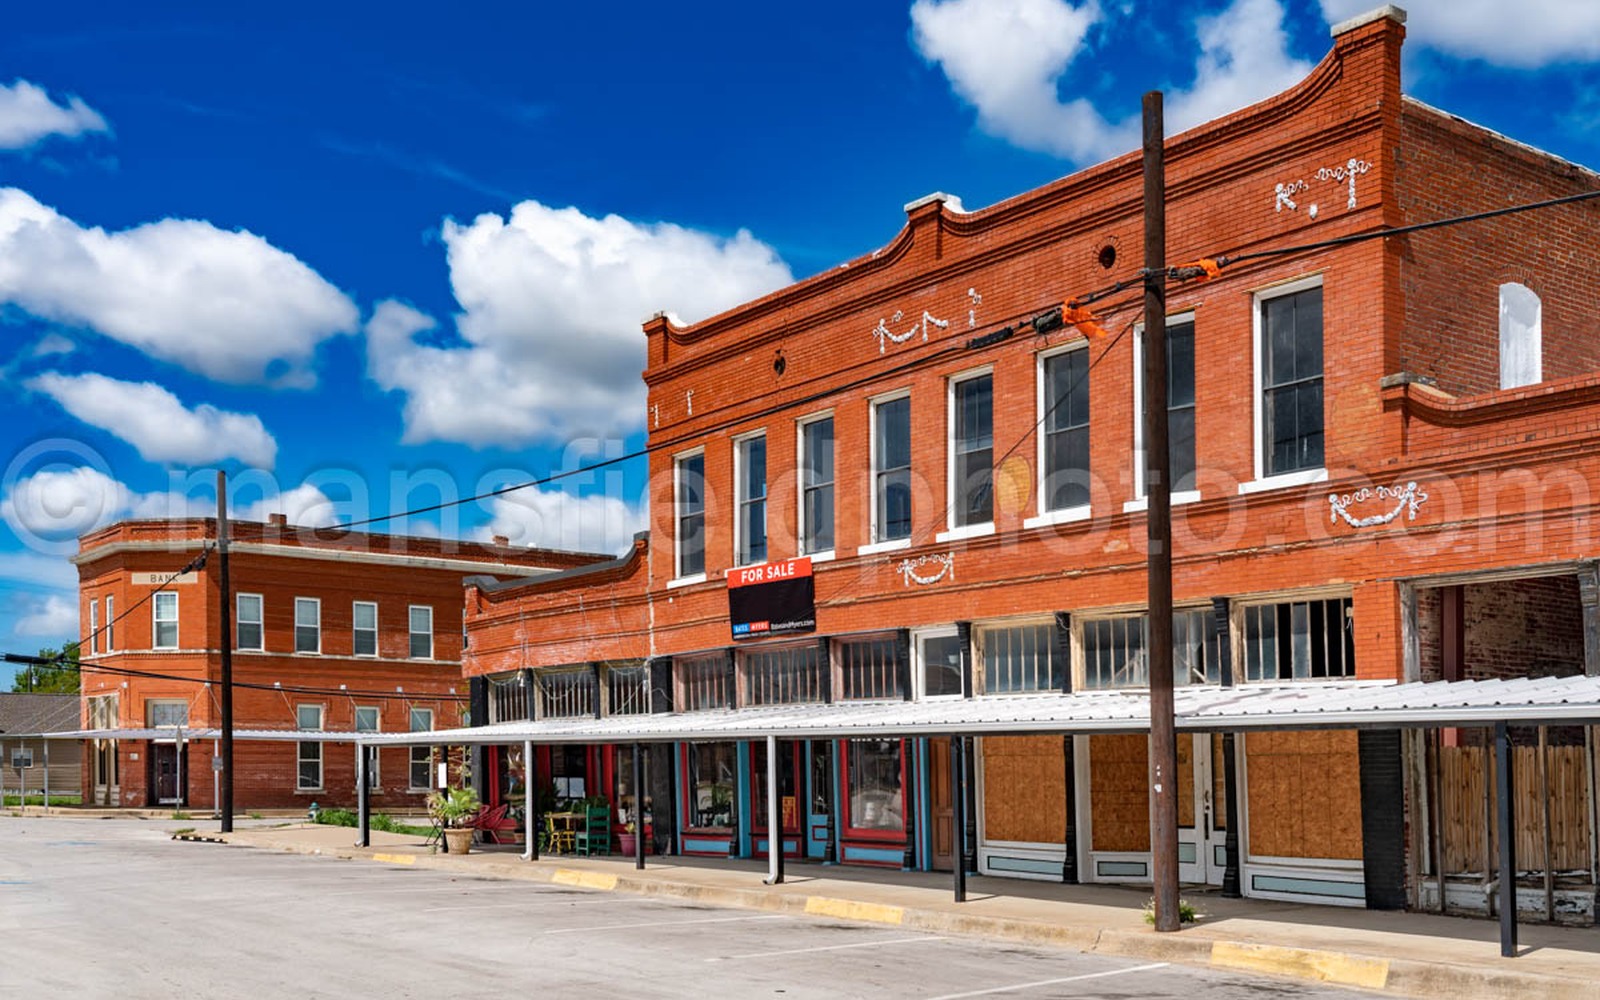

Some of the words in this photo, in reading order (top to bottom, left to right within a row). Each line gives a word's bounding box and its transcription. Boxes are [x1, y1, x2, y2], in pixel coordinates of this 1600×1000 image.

[150, 574, 178, 583] BANK
[741, 569, 763, 583] FOR
[767, 563, 795, 579] SALE
